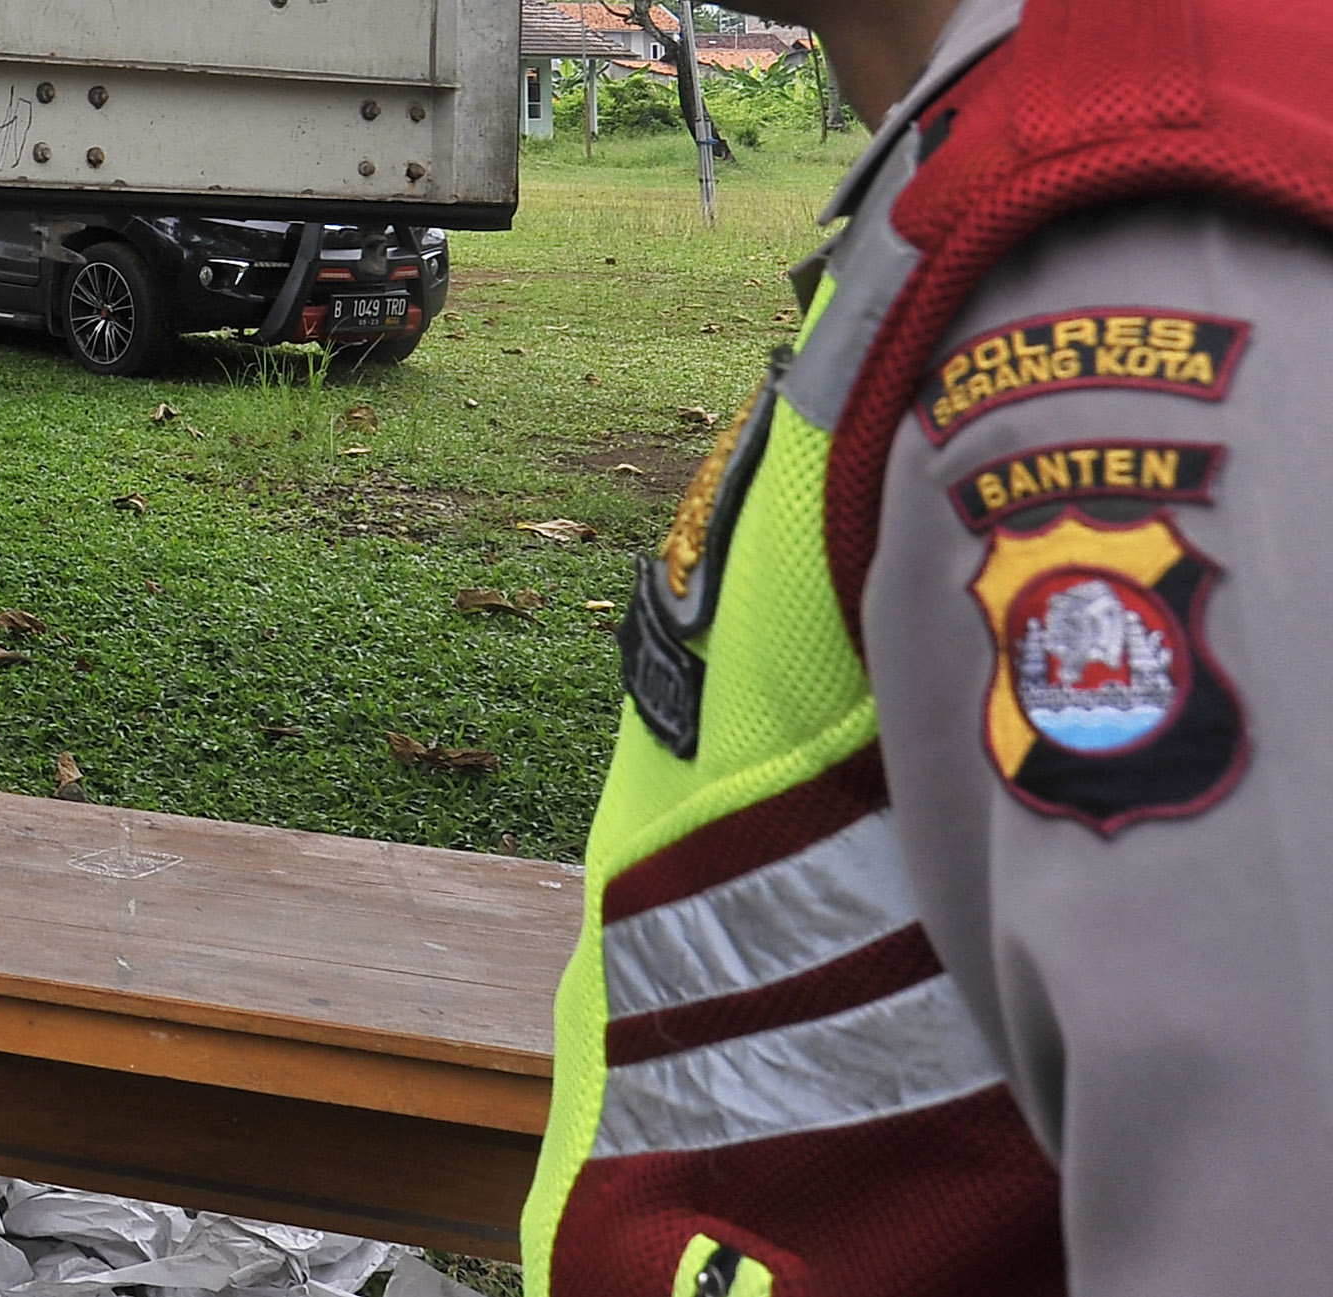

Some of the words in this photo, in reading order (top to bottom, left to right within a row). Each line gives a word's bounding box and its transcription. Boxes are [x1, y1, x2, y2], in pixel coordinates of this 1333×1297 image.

[334, 300, 343, 319] B
[353, 299, 380, 318] 1049
[385, 298, 407, 316] TRD
[935, 348, 1081, 426] SERANG
[1094, 345, 1215, 386] KOTA
[942, 316, 1198, 393] POLRES
[976, 448, 1179, 511] BANTEN
